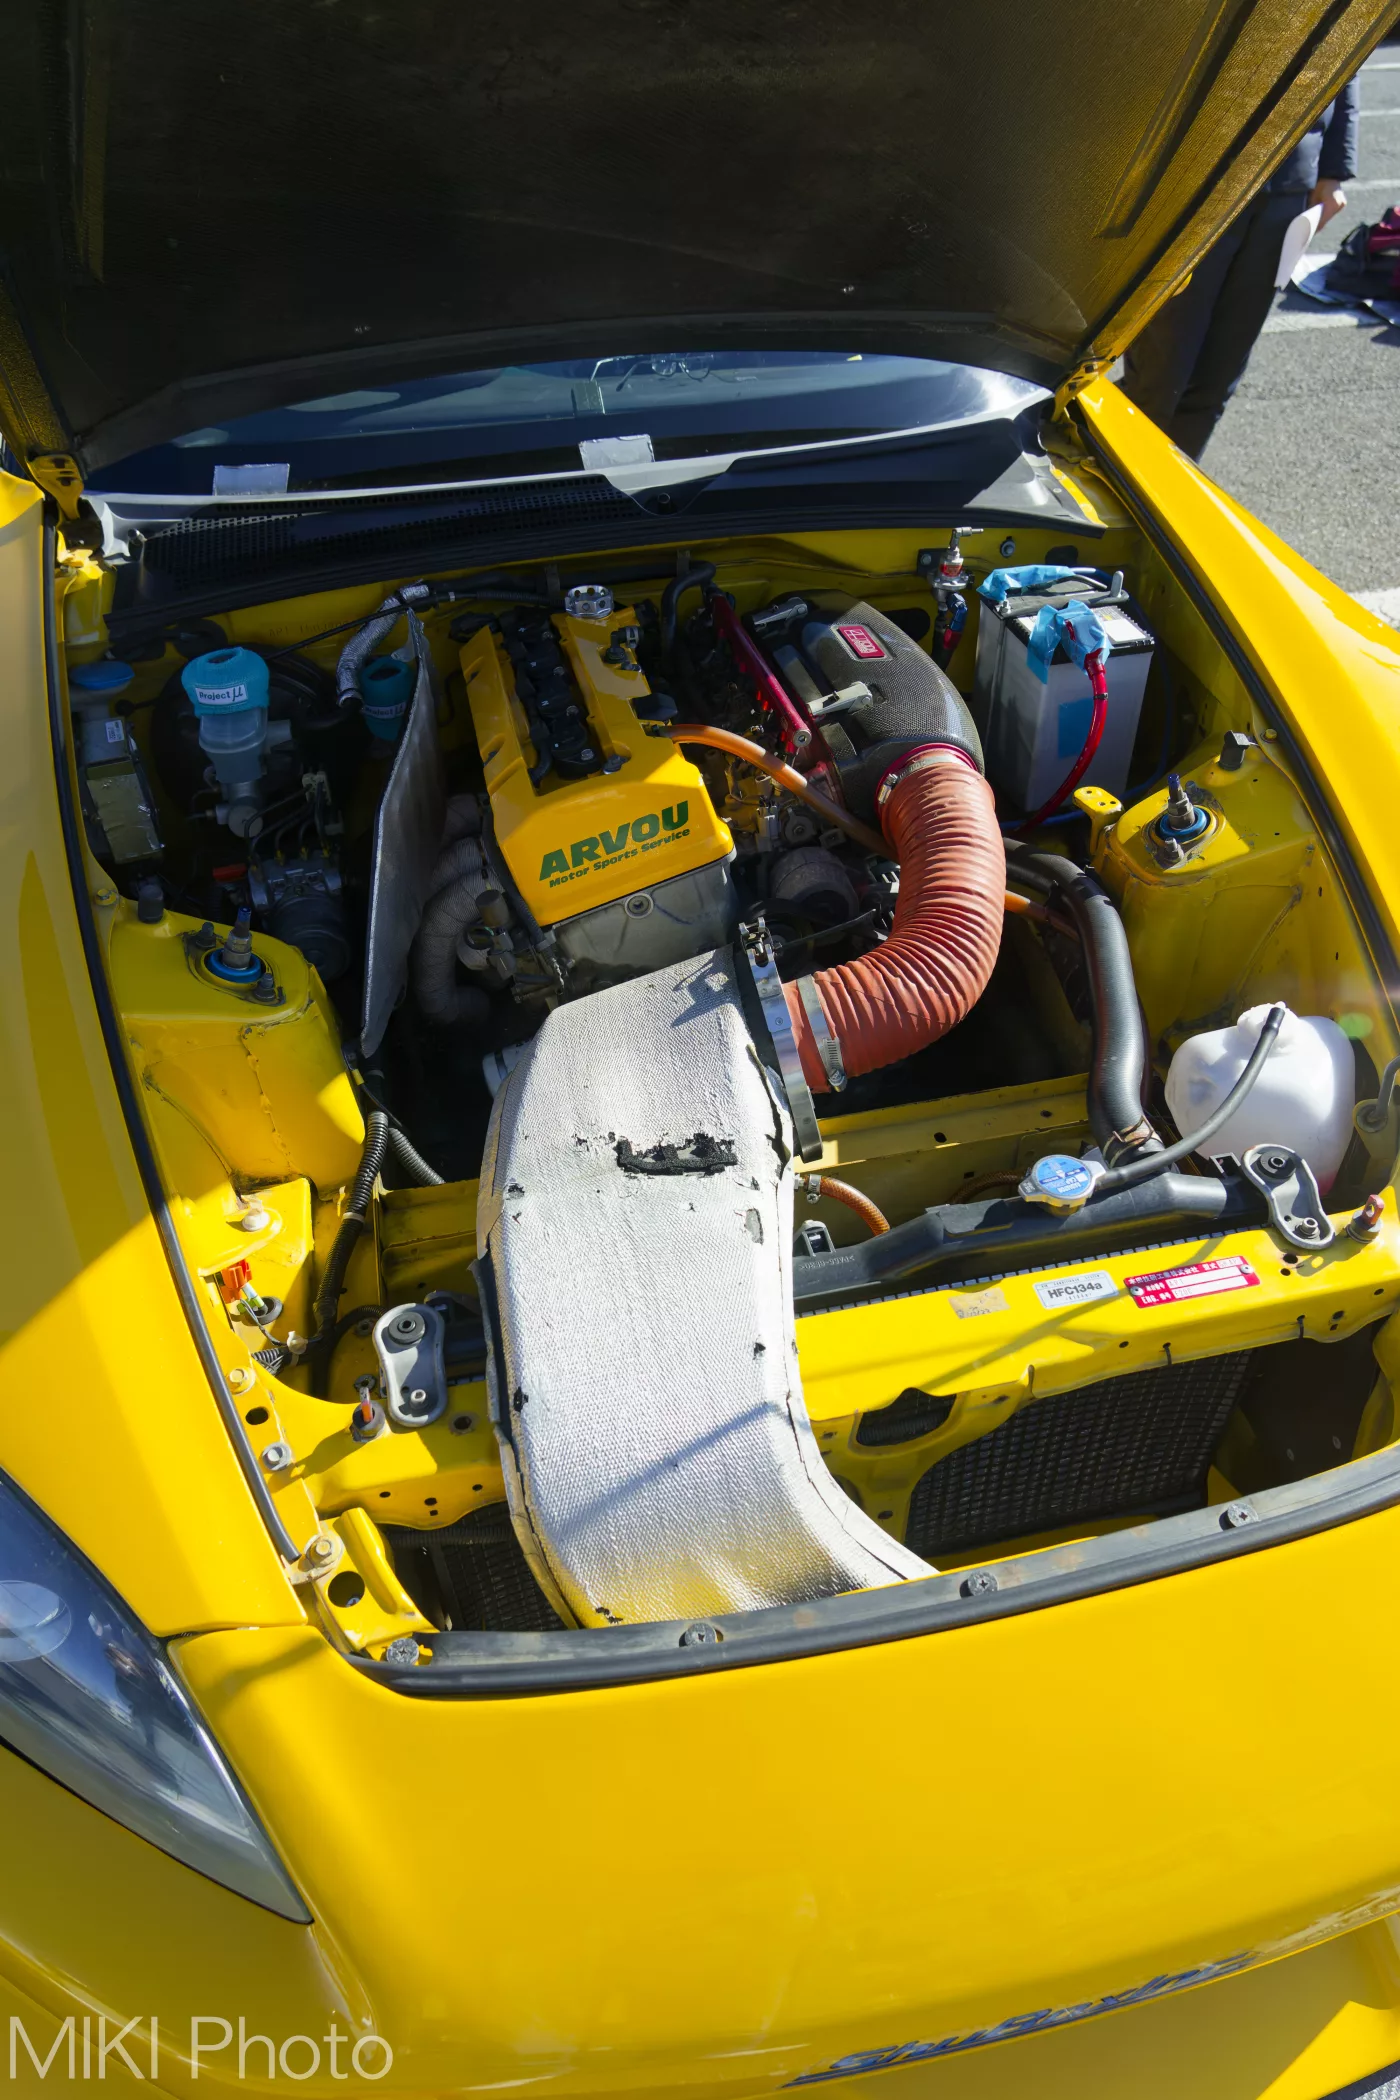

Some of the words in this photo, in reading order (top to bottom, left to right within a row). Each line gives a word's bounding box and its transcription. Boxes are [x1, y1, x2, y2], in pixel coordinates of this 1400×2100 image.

[199, 691, 231, 701] Project
[539, 800, 689, 881] ARVOU
[549, 866, 589, 888] Motor
[593, 848, 638, 872] Sports
[641, 828, 690, 852] Service
[1047, 1282, 1103, 1299] HFC134a
